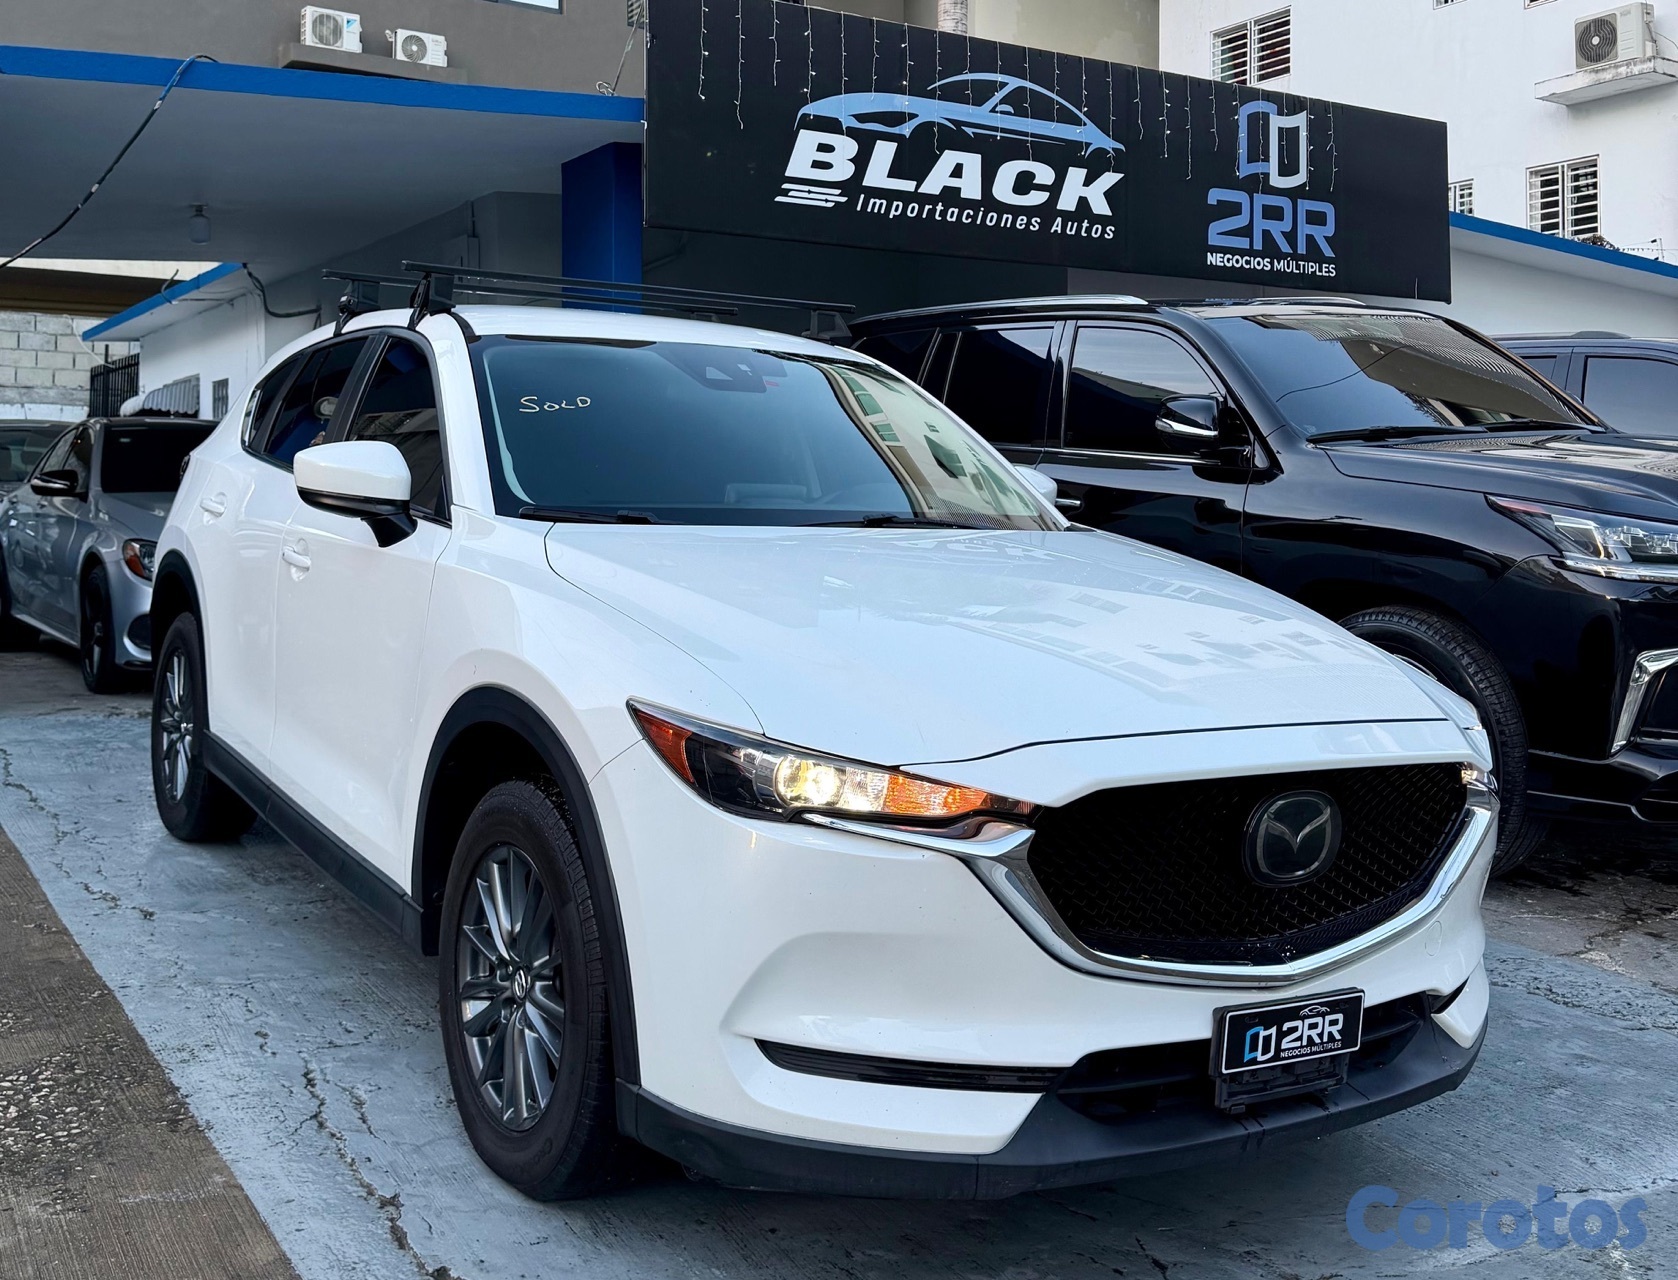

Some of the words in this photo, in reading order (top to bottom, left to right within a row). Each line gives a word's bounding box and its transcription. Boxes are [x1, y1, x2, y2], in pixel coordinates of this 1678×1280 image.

[784, 129, 1125, 216] BLACK
[856, 193, 1041, 232] Importaciones
[1050, 216, 1115, 240] Autos
[1207, 187, 1336, 258] 2RR
[1207, 252, 1271, 271] NEGOCIOS
[1273, 257, 1336, 277] MÚLTIPLES
[519, 396, 591, 413] SOLD
[1281, 1013, 1344, 1050] 2RR
[1280, 1047, 1311, 1058] NEGOCIOS
